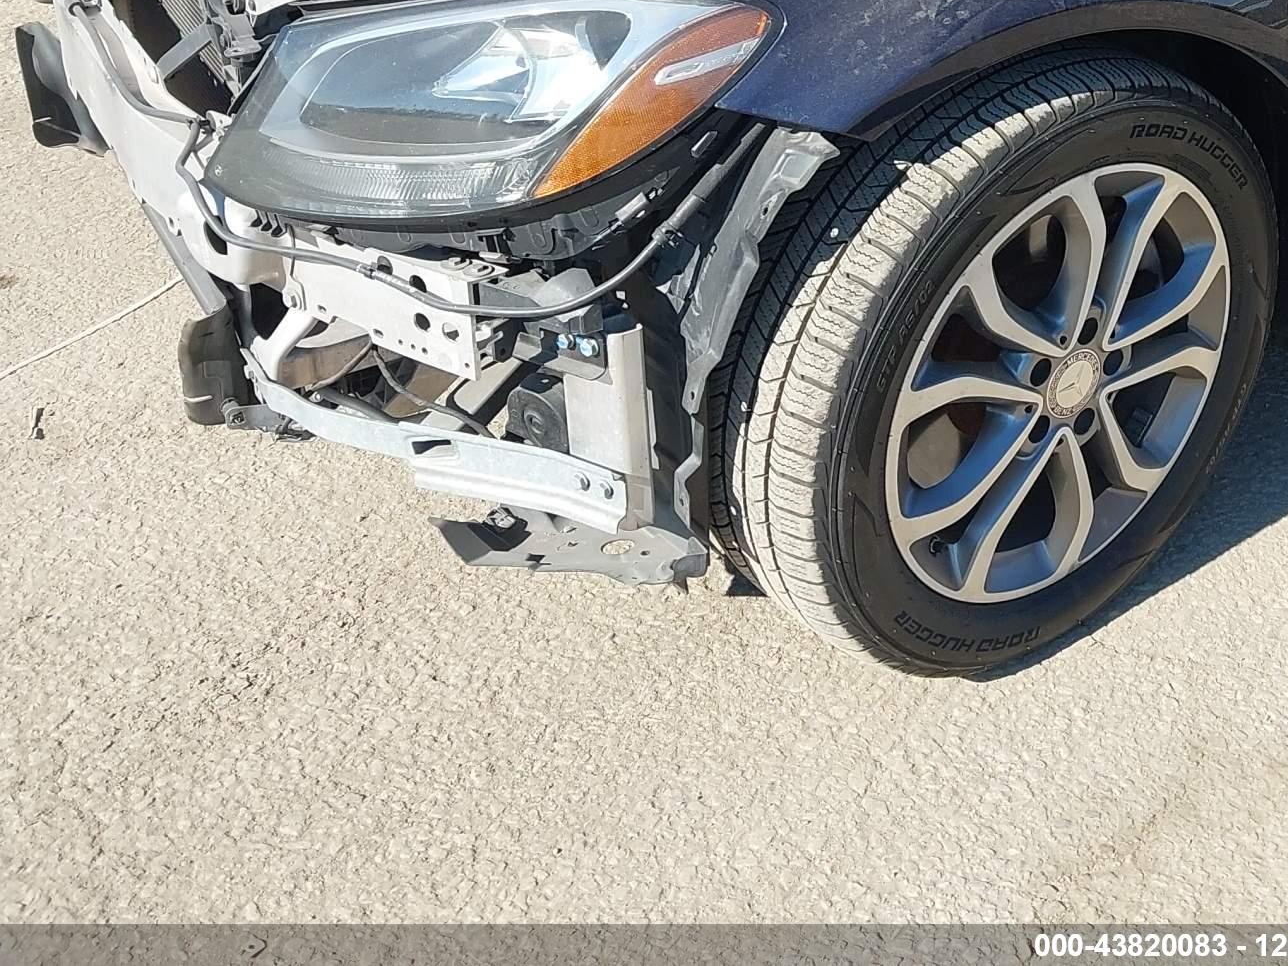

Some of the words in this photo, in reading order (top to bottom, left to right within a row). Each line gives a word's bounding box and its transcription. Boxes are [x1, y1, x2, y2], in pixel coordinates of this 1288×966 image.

[1129, 123, 1188, 141] ROAD
[1187, 131, 1249, 190] HUGGER
[894, 610, 975, 652] HUGGER
[975, 625, 1041, 652] ROAD
